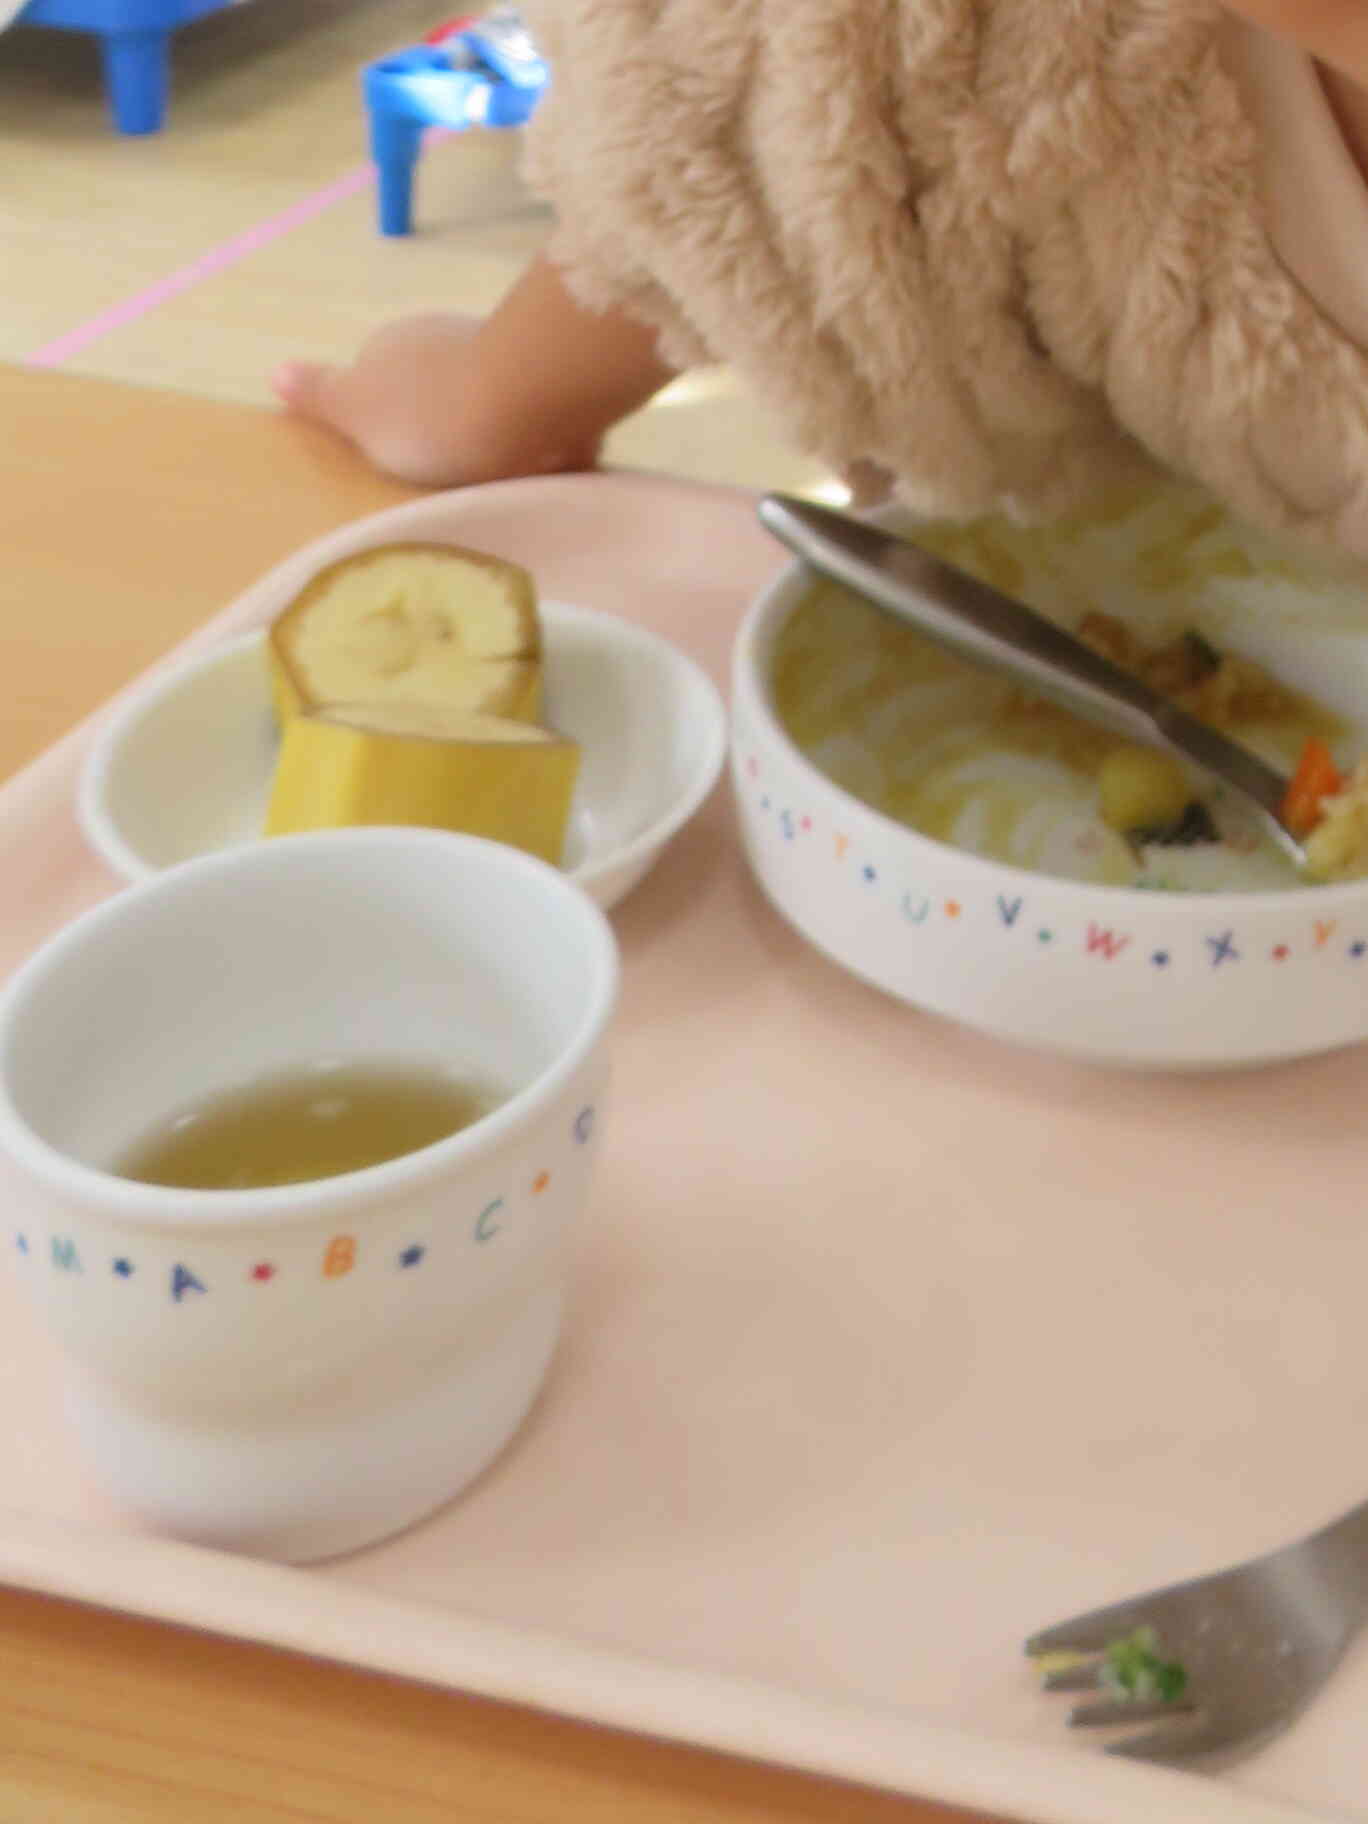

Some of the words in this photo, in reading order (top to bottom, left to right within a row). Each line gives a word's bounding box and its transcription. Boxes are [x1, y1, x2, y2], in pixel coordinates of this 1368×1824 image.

[901, 892, 931, 926] U
[996, 895, 1023, 928] V
[1085, 920, 1134, 960] W
[1205, 929, 1241, 968] X
[170, 1262, 209, 1304] A
[322, 1233, 358, 1281] B
[473, 1197, 504, 1245] C
